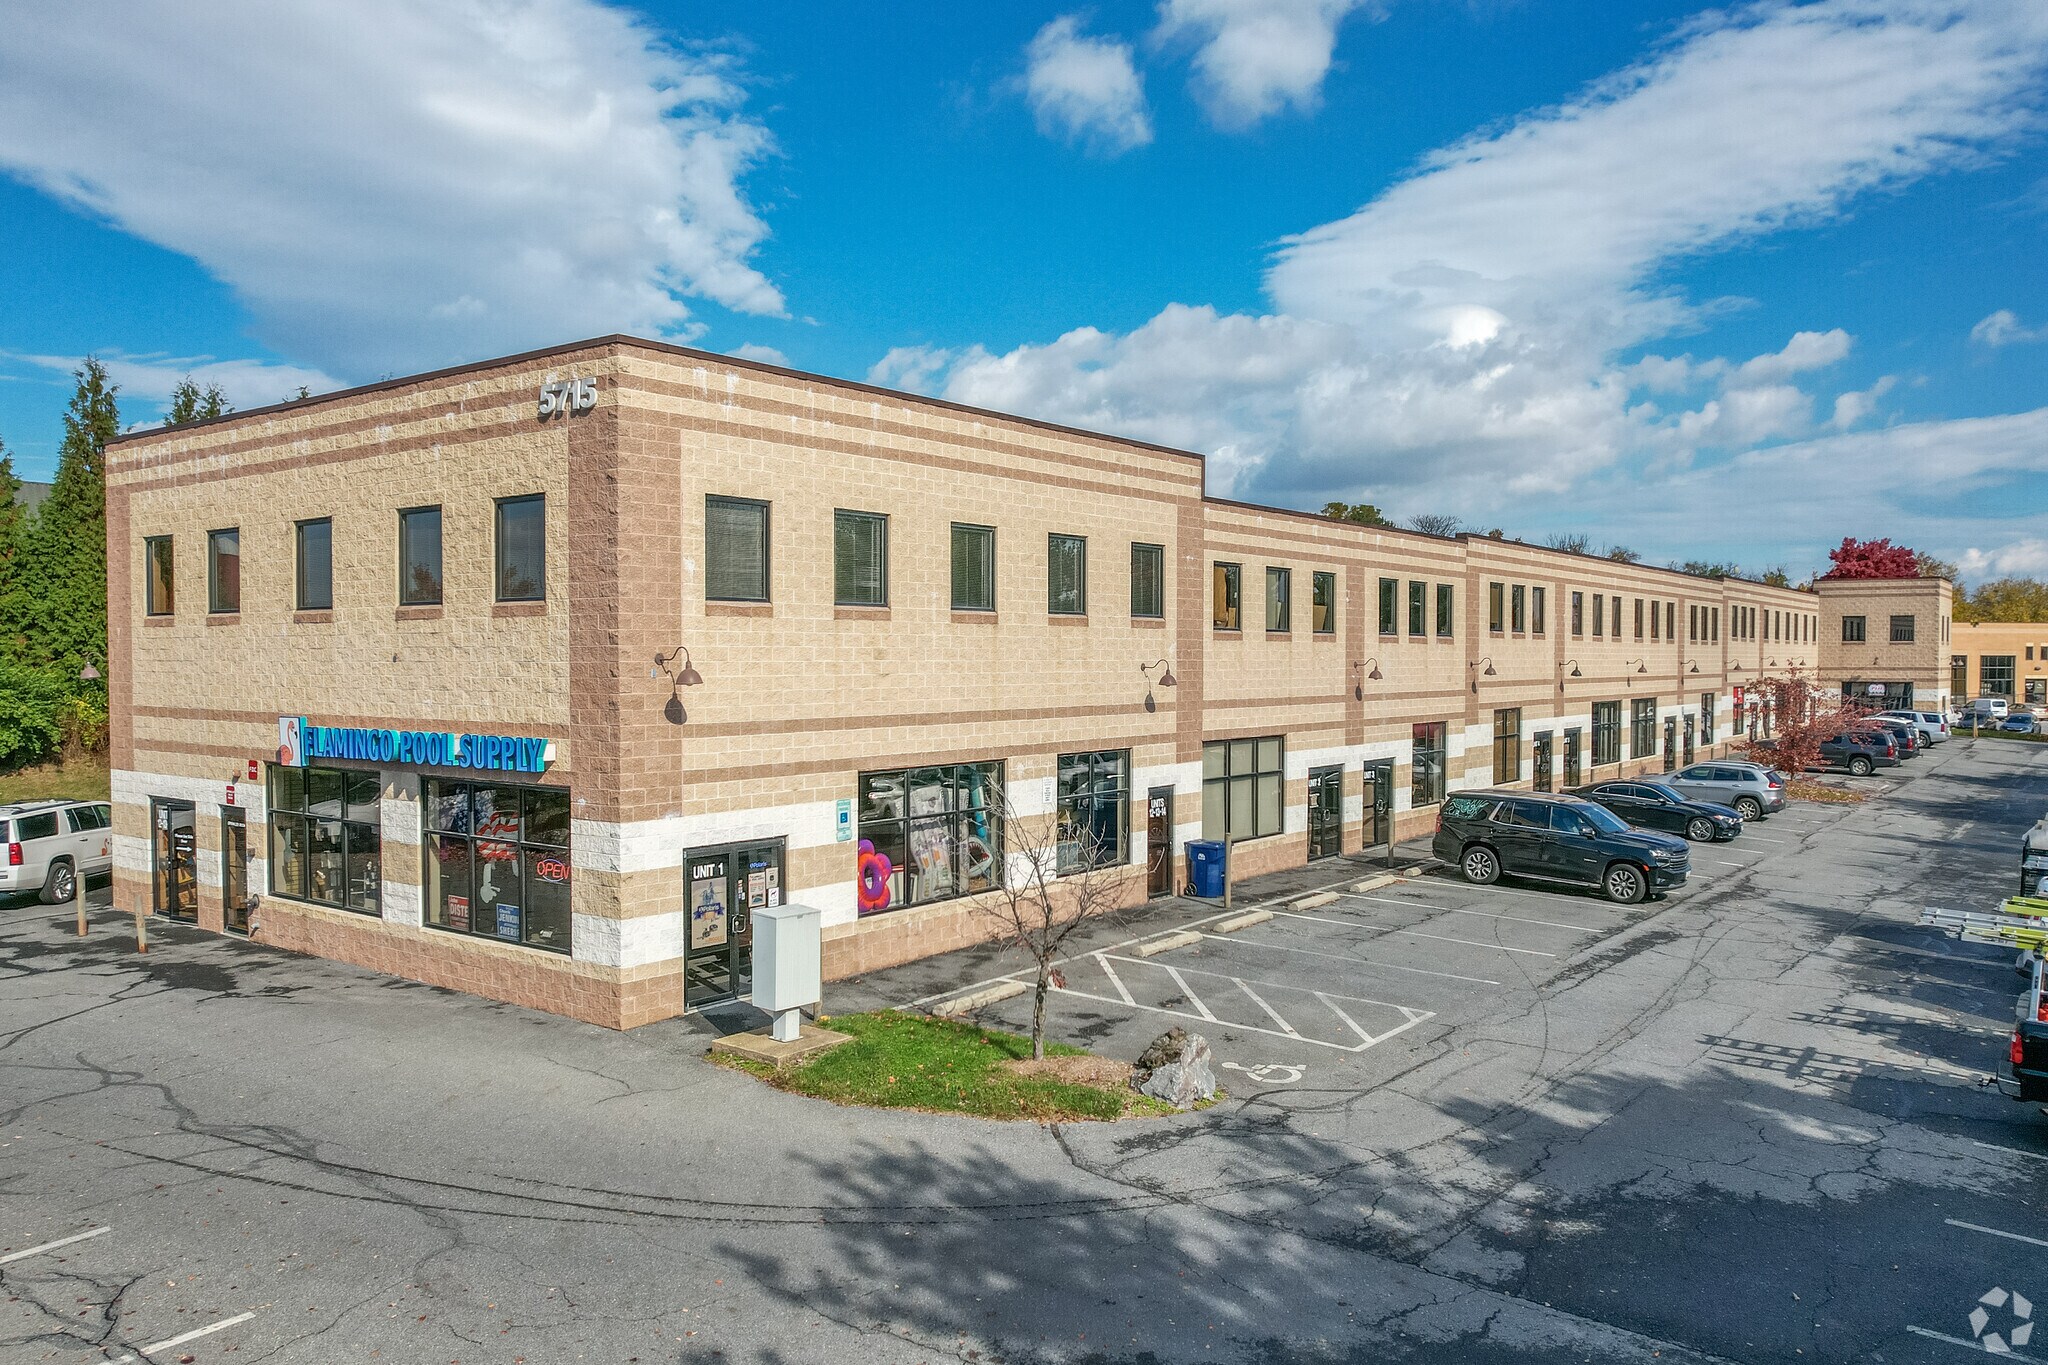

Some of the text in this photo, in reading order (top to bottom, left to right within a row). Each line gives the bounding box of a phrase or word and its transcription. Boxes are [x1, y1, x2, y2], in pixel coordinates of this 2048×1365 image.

[539, 377, 598, 414] 5715
[303, 726, 542, 772] FLAMINGO POOL SUPPLY
[1150, 797, 1165, 808] UNITS
[536, 861, 570, 880] OPEN
[693, 862, 724, 879] UNIT 1
